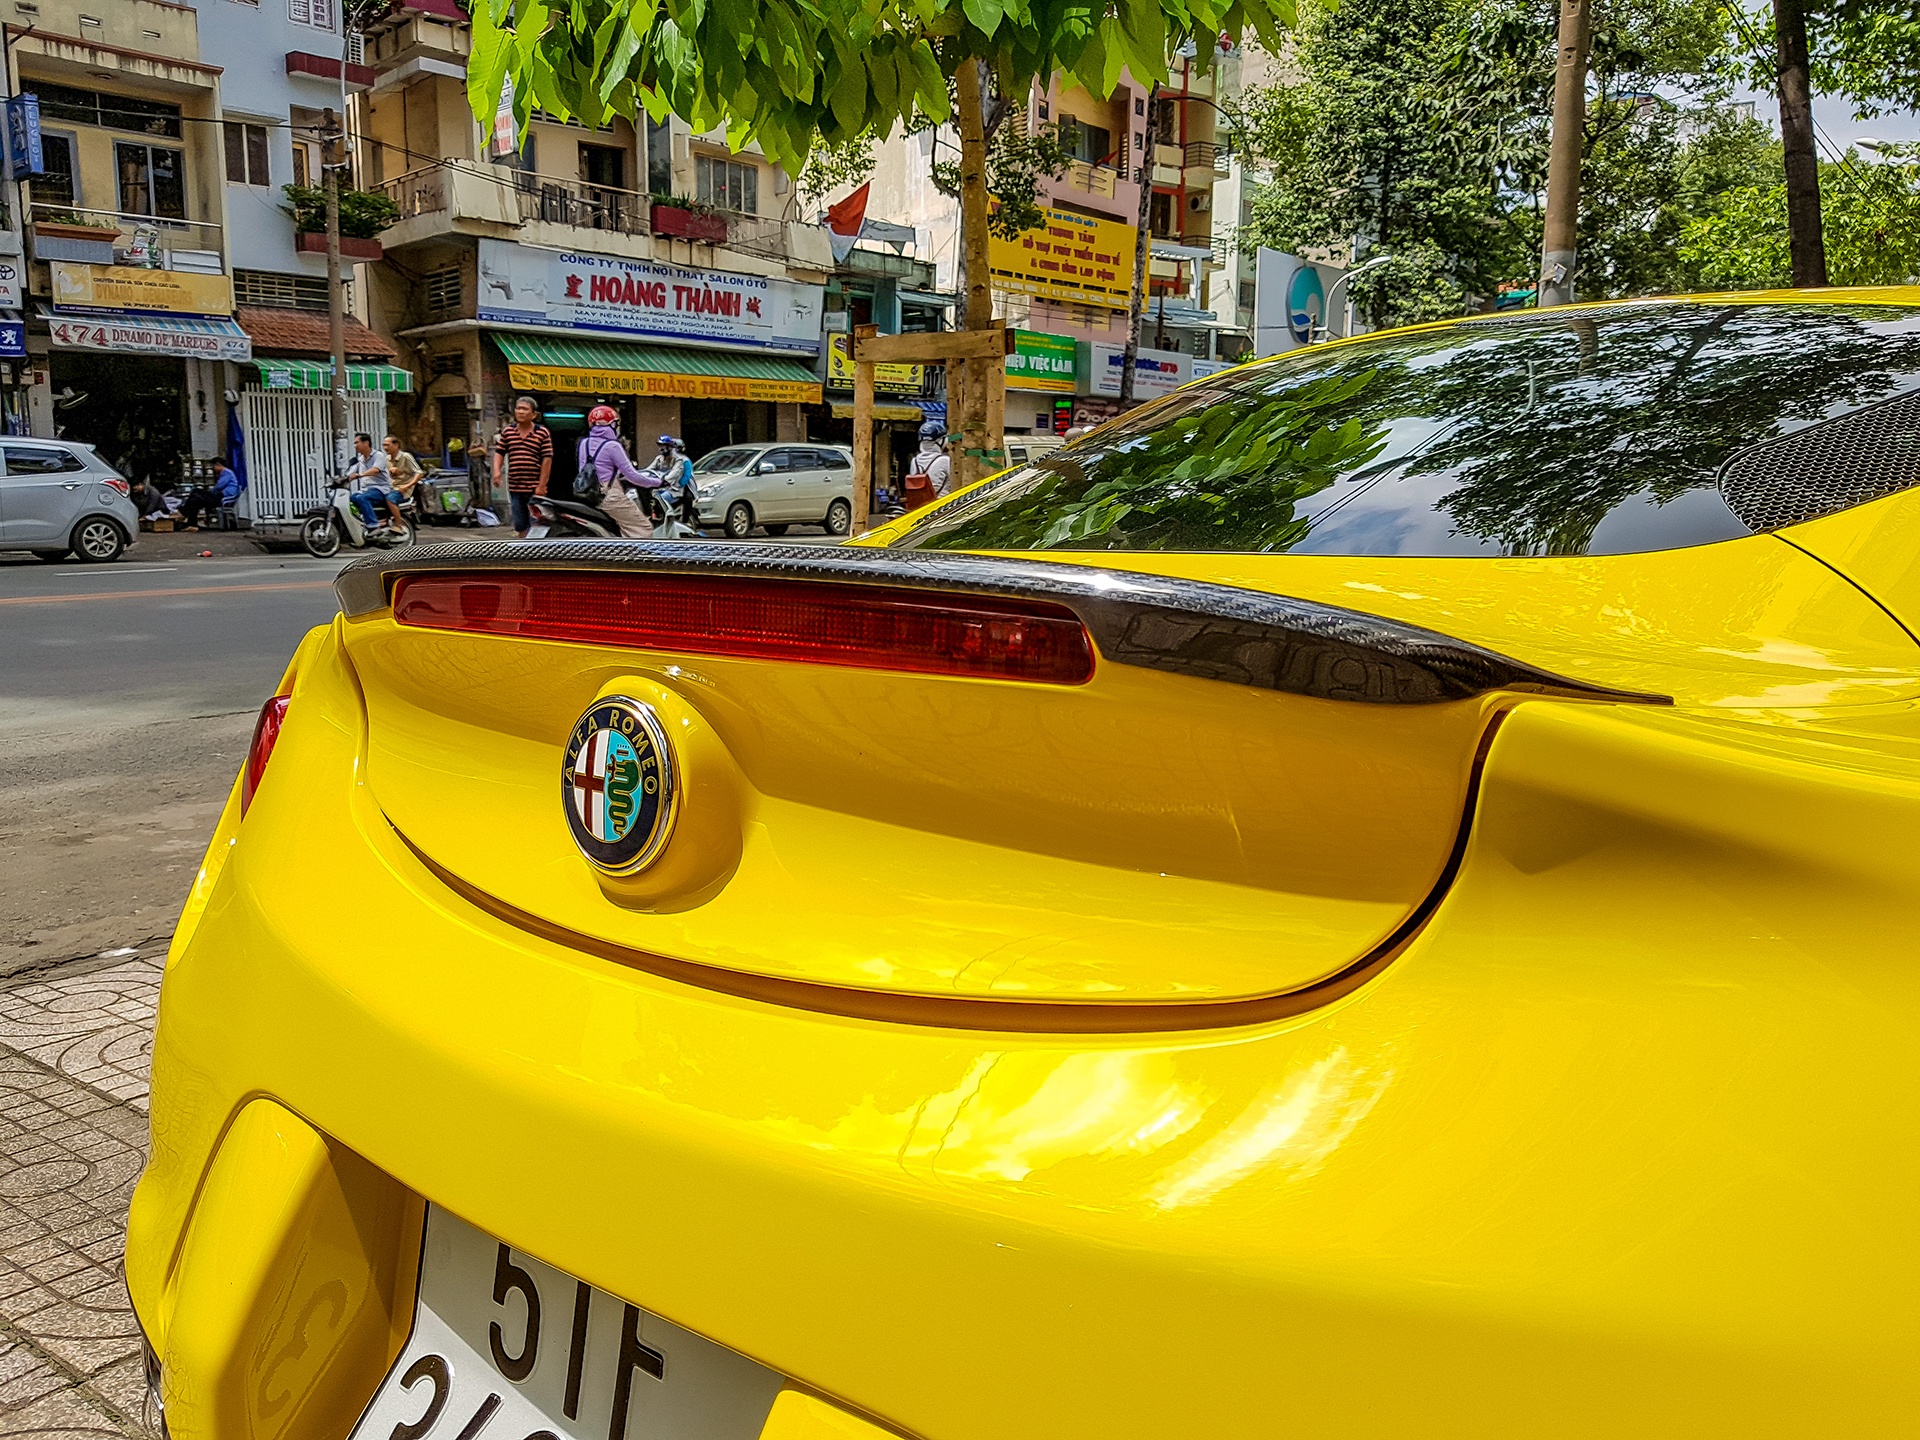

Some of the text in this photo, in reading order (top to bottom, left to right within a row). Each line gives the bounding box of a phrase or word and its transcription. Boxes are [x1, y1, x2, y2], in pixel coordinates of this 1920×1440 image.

[598, 259, 615, 269] TY
[617, 262, 650, 274] TNHH
[708, 274, 744, 287] SALON
[590, 272, 742, 317] HOÀNG THÀNH
[54, 322, 110, 347] 474
[224, 341, 245, 349] 474
[1028, 353, 1050, 374] VIỆC
[1051, 356, 1073, 373] LÀM
[550, 373, 558, 387] TY
[610, 377, 630, 391] SALON
[646, 375, 696, 394] HOÀNG
[701, 378, 747, 397] THÀNH
[565, 709, 658, 795] ALFA ROMEO
